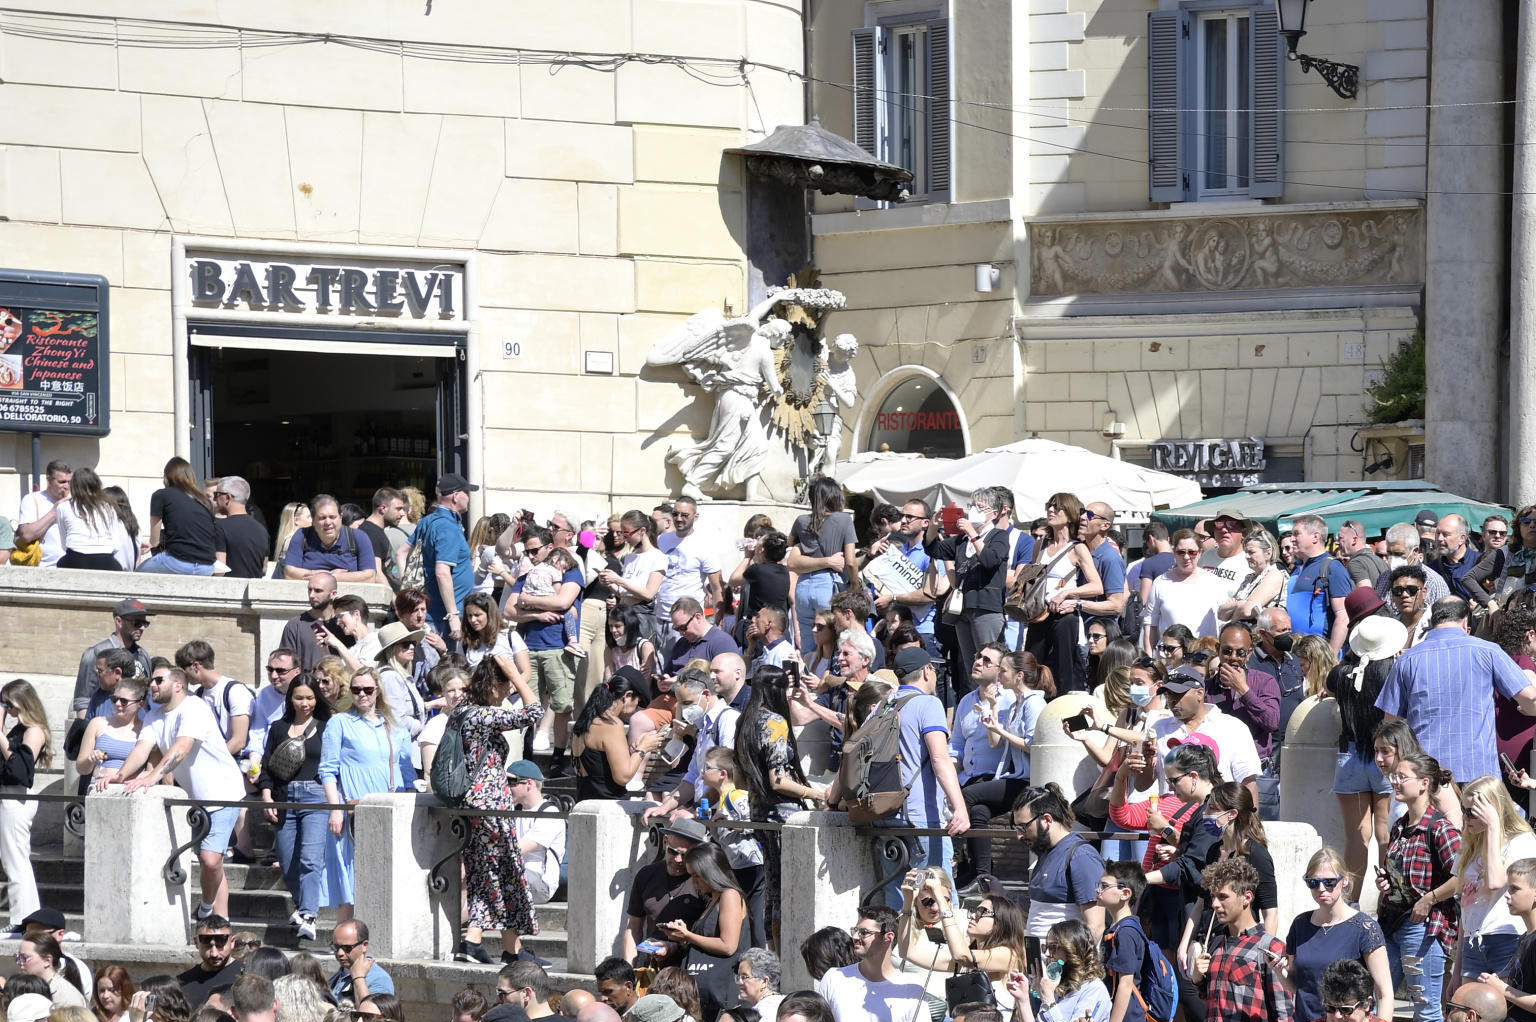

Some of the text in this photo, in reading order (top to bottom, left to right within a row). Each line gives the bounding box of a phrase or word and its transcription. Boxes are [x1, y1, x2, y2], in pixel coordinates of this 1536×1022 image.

[190, 260, 454, 316] BAR TREVI
[26, 334, 88, 348] Ristorante
[505, 342, 521, 356] 90
[25, 356, 94, 370] Chinese and
[9, 405, 45, 413] 6785525
[70, 416, 82, 424] 50
[1213, 566, 1236, 581] DIESEL
